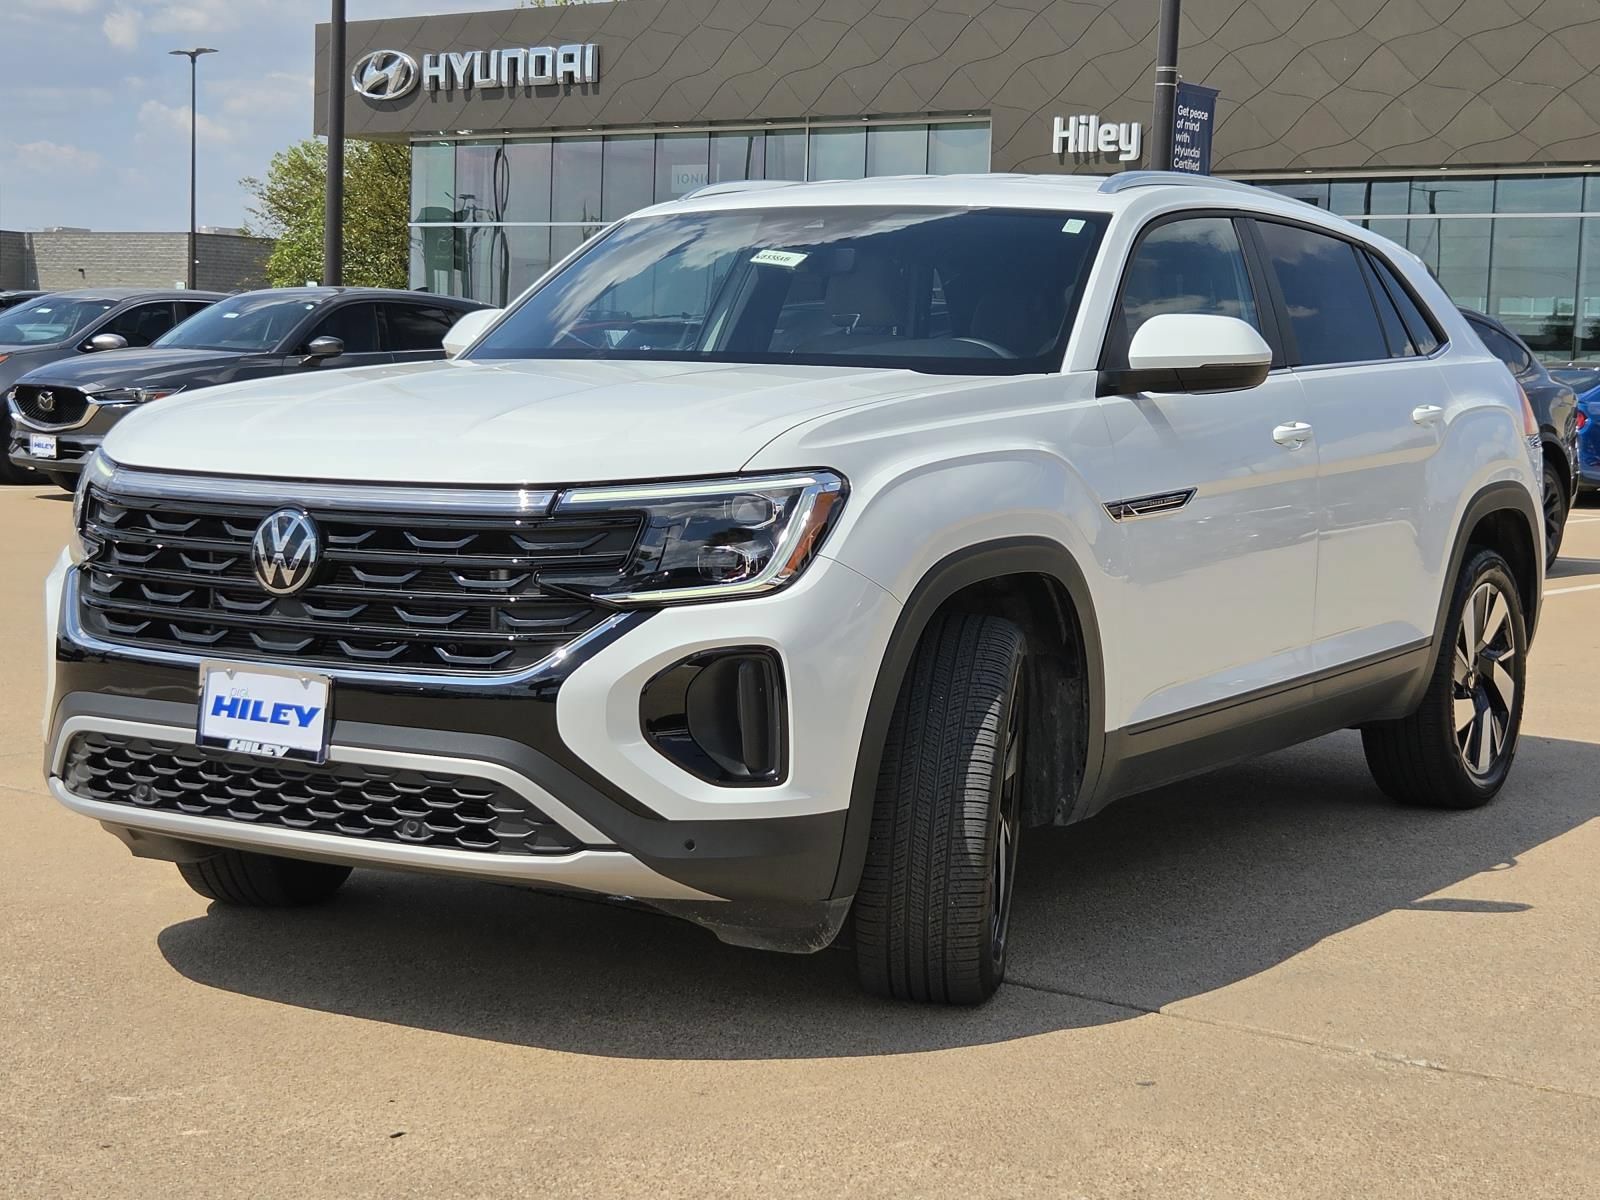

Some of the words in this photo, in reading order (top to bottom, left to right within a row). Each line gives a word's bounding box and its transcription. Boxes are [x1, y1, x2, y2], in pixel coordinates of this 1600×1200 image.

[423, 44, 600, 91] HYUNDAI
[1177, 104, 1190, 117] Get
[1190, 109, 1209, 121] peace
[1176, 118, 1185, 129] of
[1184, 119, 1200, 132] mind
[1052, 114, 1142, 161] Hiley
[1175, 131, 1190, 143] with
[1174, 144, 1201, 158] Hyundai
[1173, 157, 1200, 171] Certified
[211, 695, 321, 728] HILEY
[227, 739, 290, 757] HILEY
